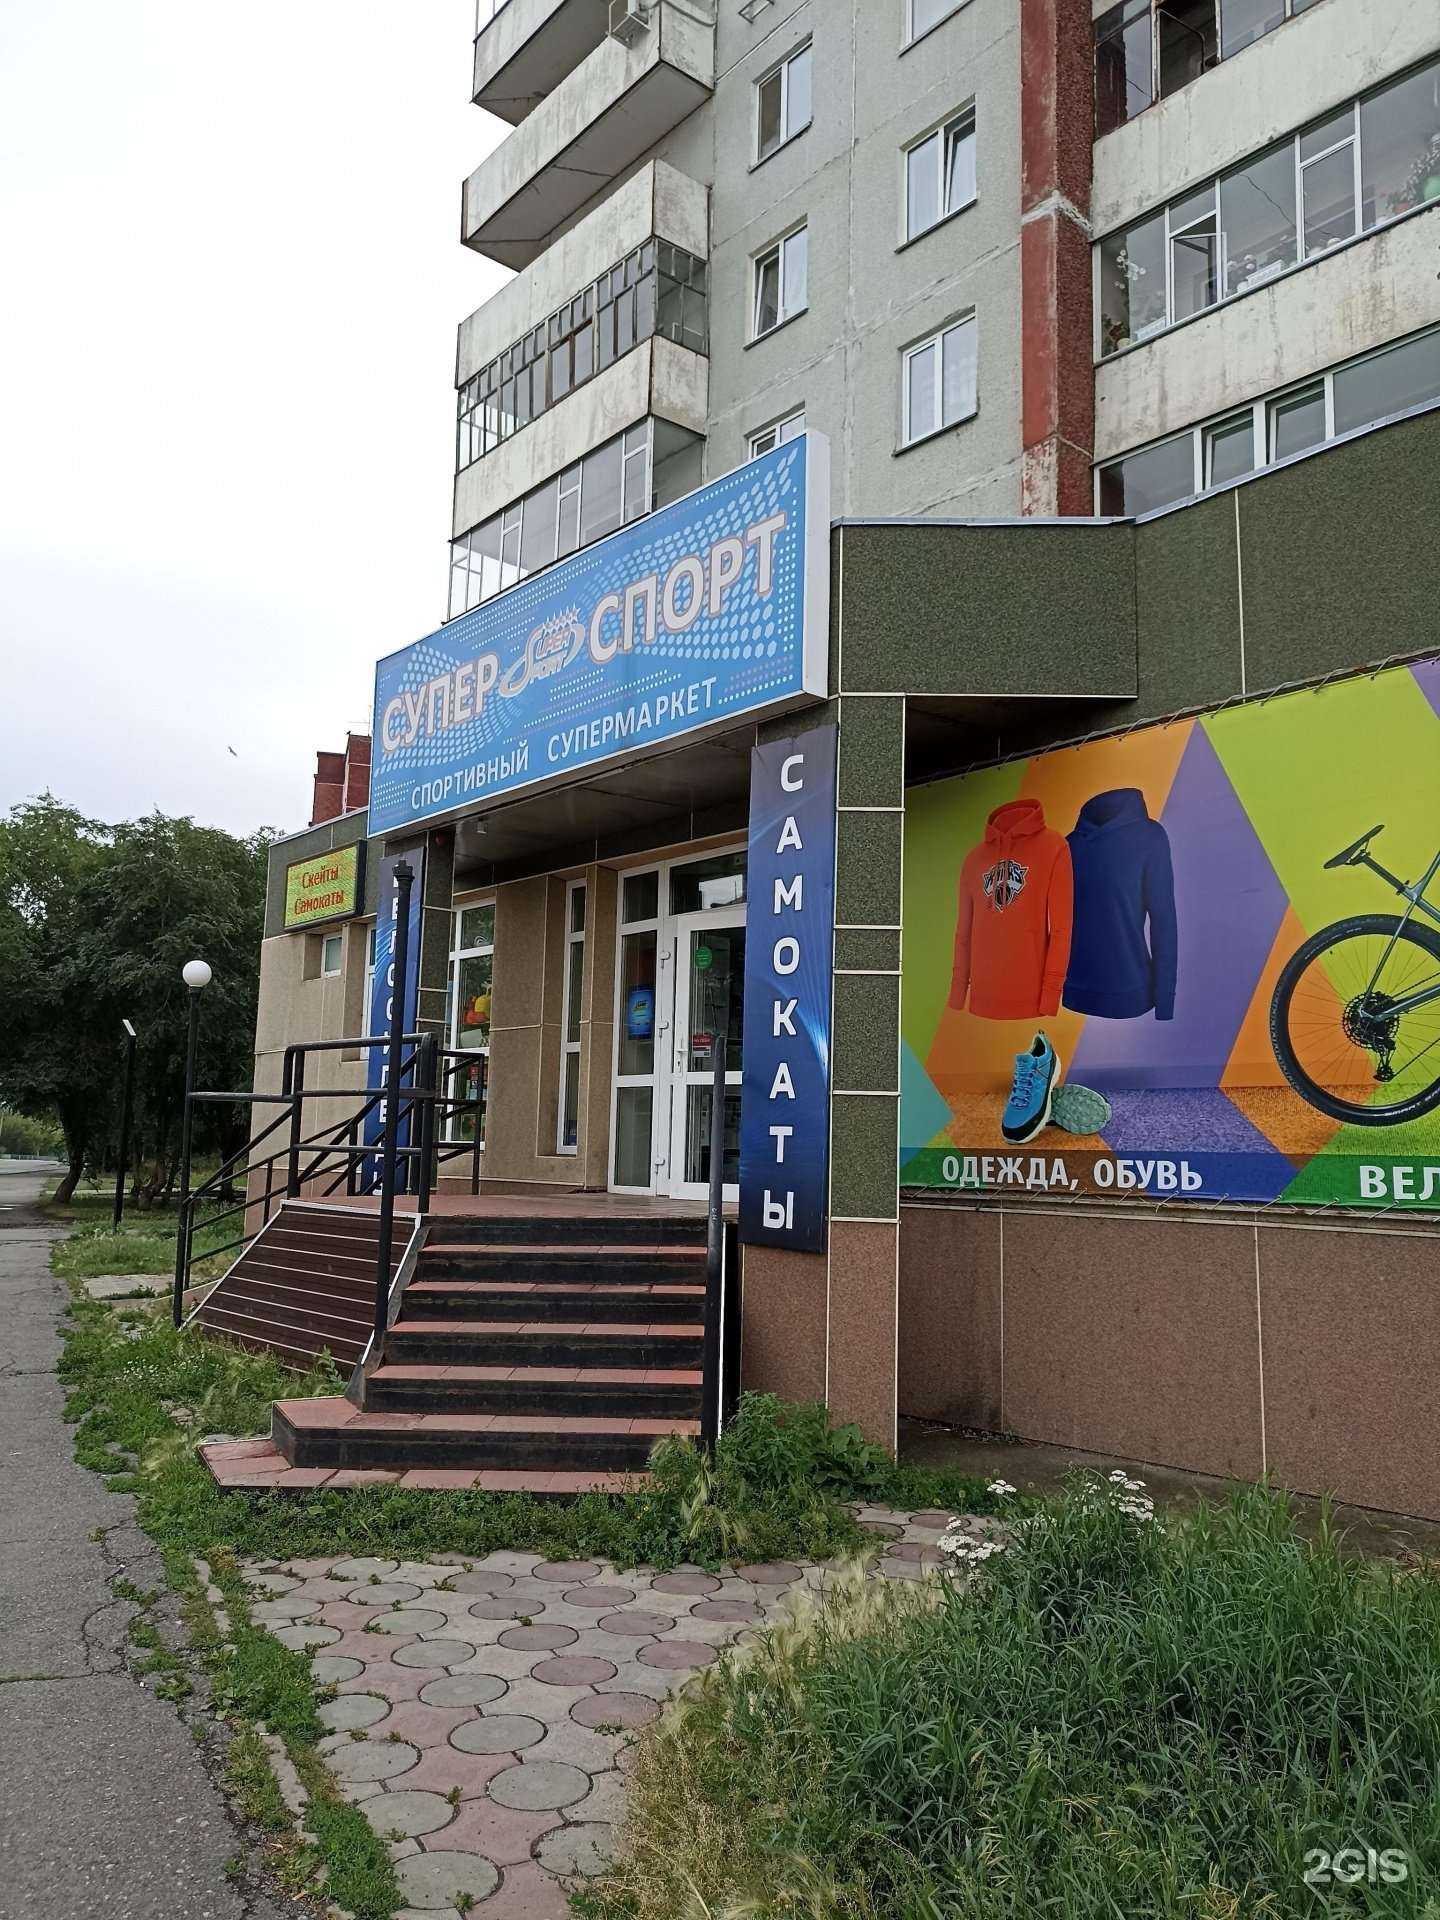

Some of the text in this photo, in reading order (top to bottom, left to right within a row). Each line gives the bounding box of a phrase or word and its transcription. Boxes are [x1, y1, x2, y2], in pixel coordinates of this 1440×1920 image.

[381, 512, 786, 752] СУПЕР СПОРТ
[411, 677, 718, 810] СПОРТИВНЫЙ СУПЕРМАРКЕТ
[294, 890, 344, 915] Самокаты
[302, 865, 339, 888] Скейты
[762, 753, 805, 1230] САМОКАТЫ
[942, 1155, 1079, 1191] ОДЕЖДА,
[1093, 1158, 1203, 1191] ОБУВЬ
